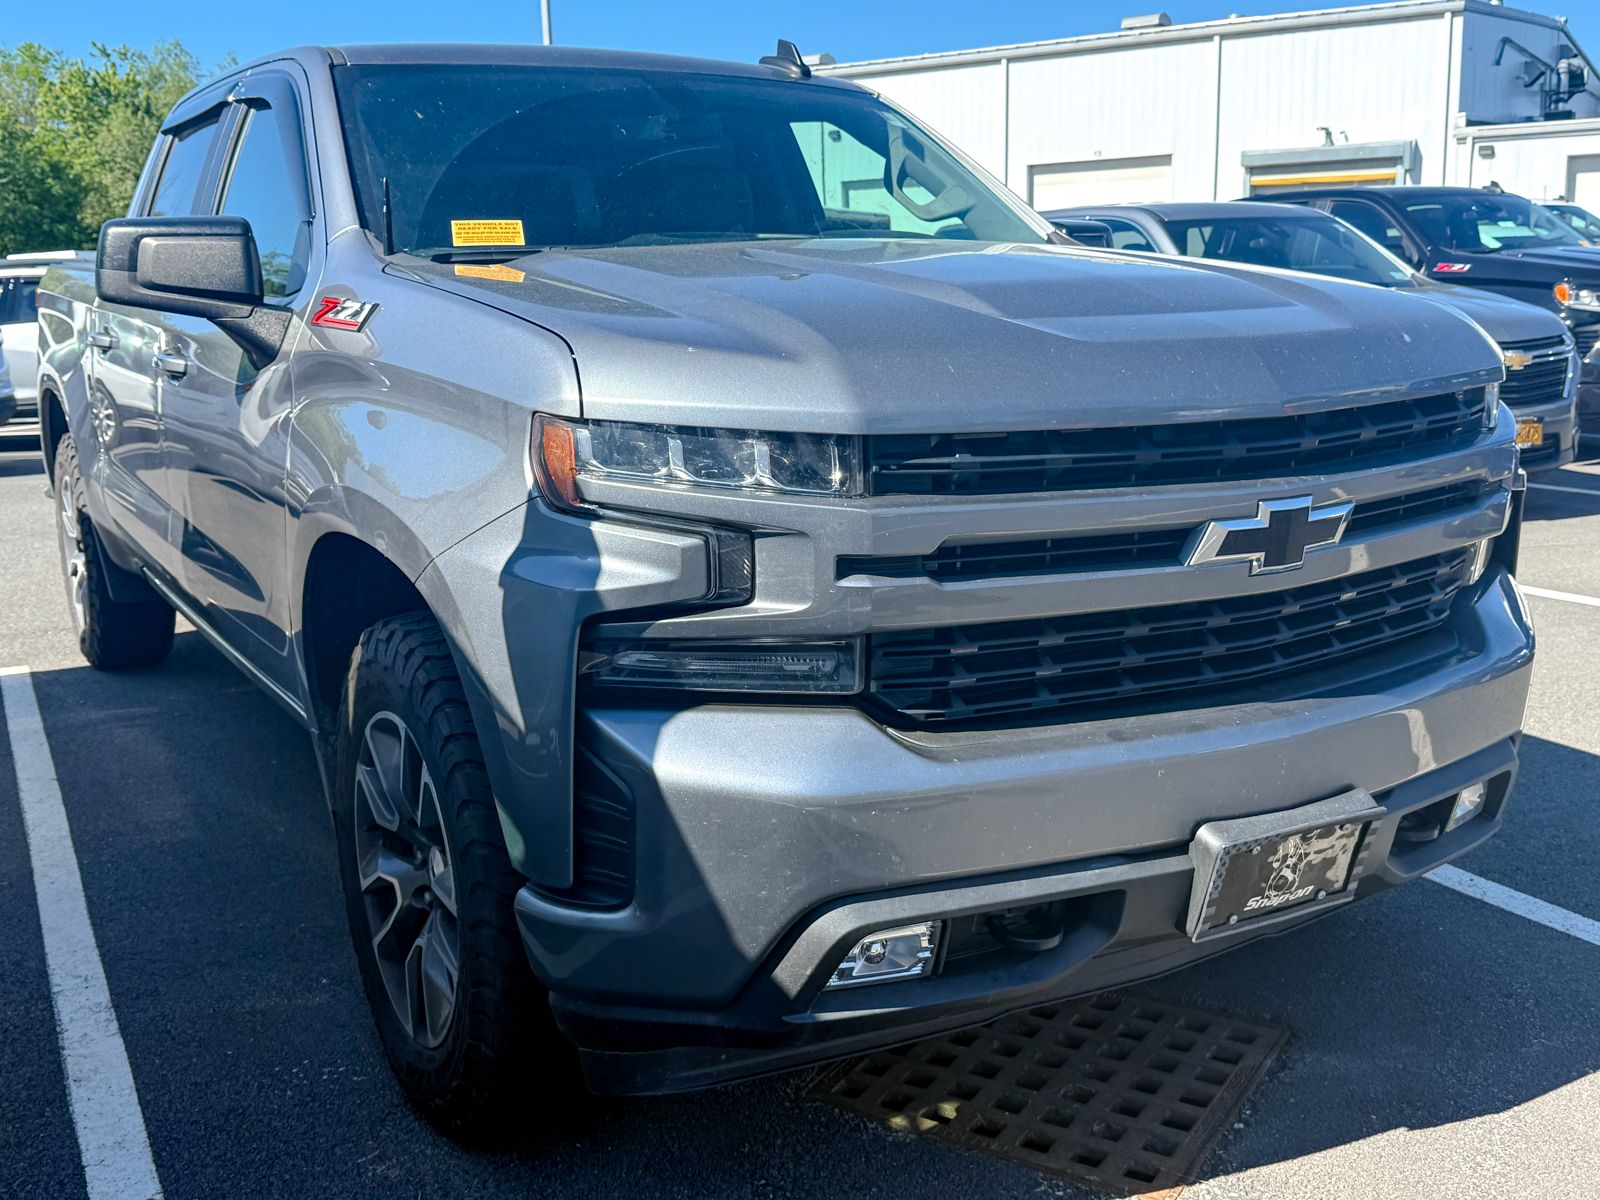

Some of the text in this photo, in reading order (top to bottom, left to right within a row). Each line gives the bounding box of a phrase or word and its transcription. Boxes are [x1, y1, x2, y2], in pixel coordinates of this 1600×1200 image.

[1432, 262, 1472, 273] Z71
[311, 297, 379, 333] Z71
[1243, 885, 1315, 911] Snap-on
